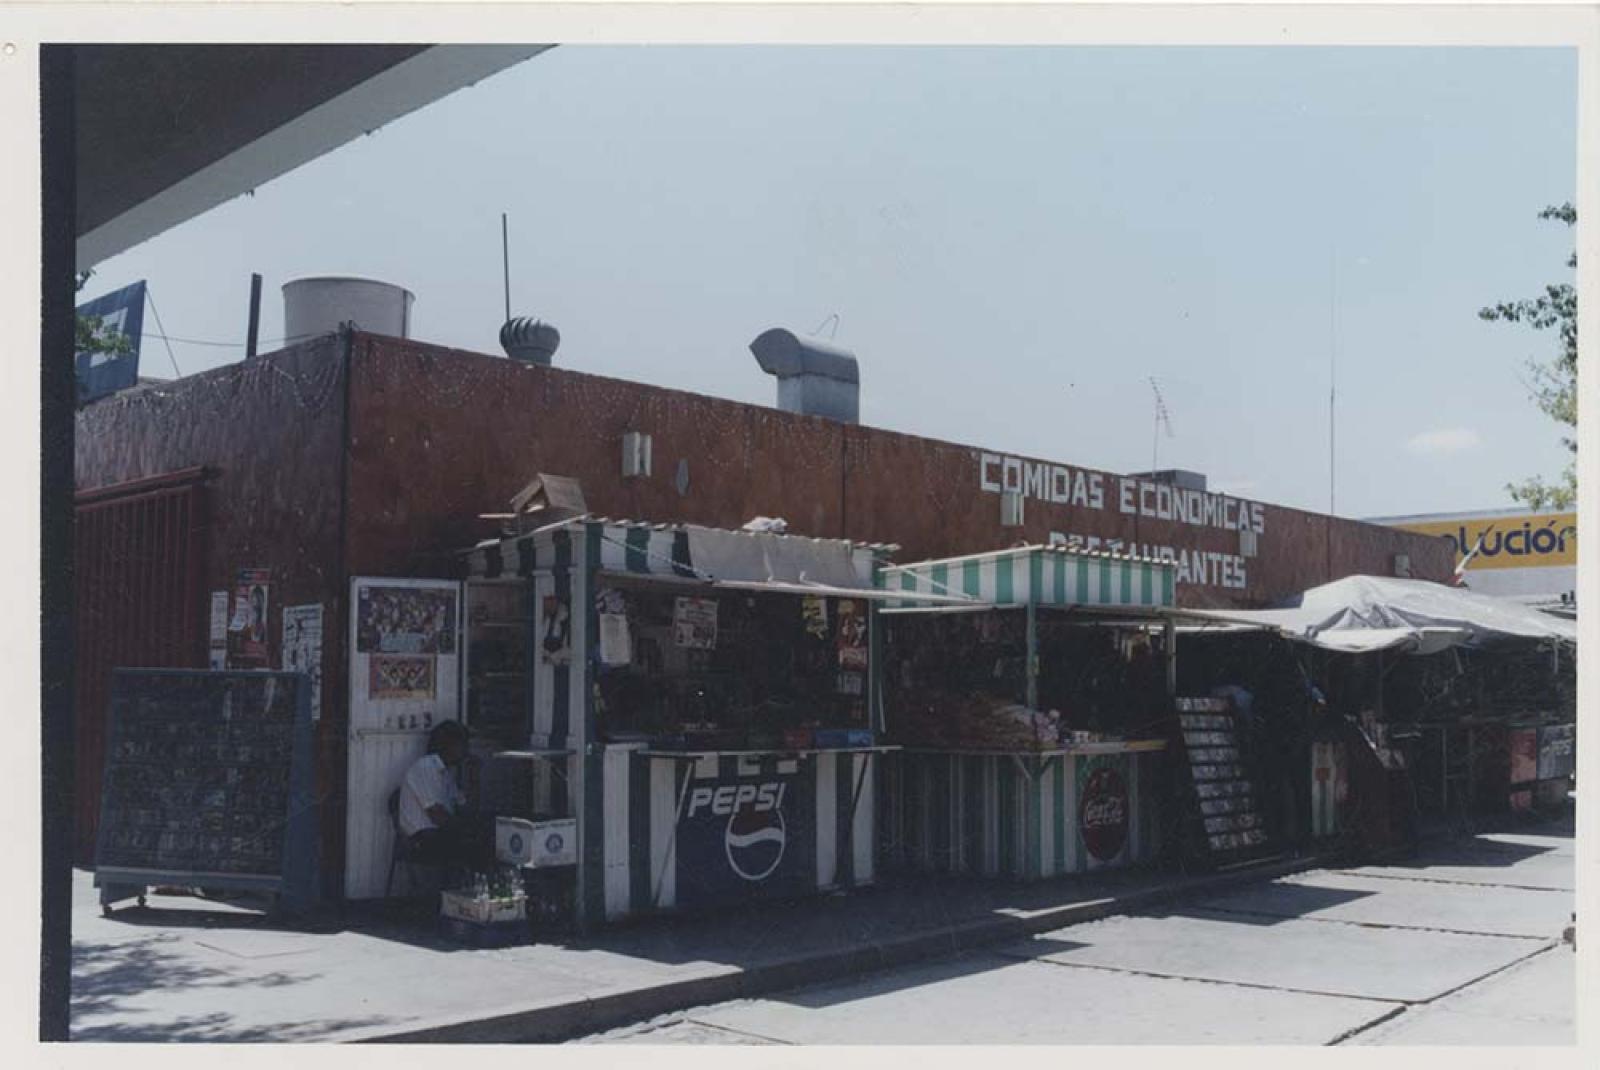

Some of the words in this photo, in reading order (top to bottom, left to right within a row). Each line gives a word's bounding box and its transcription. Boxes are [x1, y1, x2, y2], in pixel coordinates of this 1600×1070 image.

[980, 450, 1105, 510] COMIDAS
[1119, 478, 1265, 534] ECONOMICAS
[687, 783, 786, 817] PEPSI
